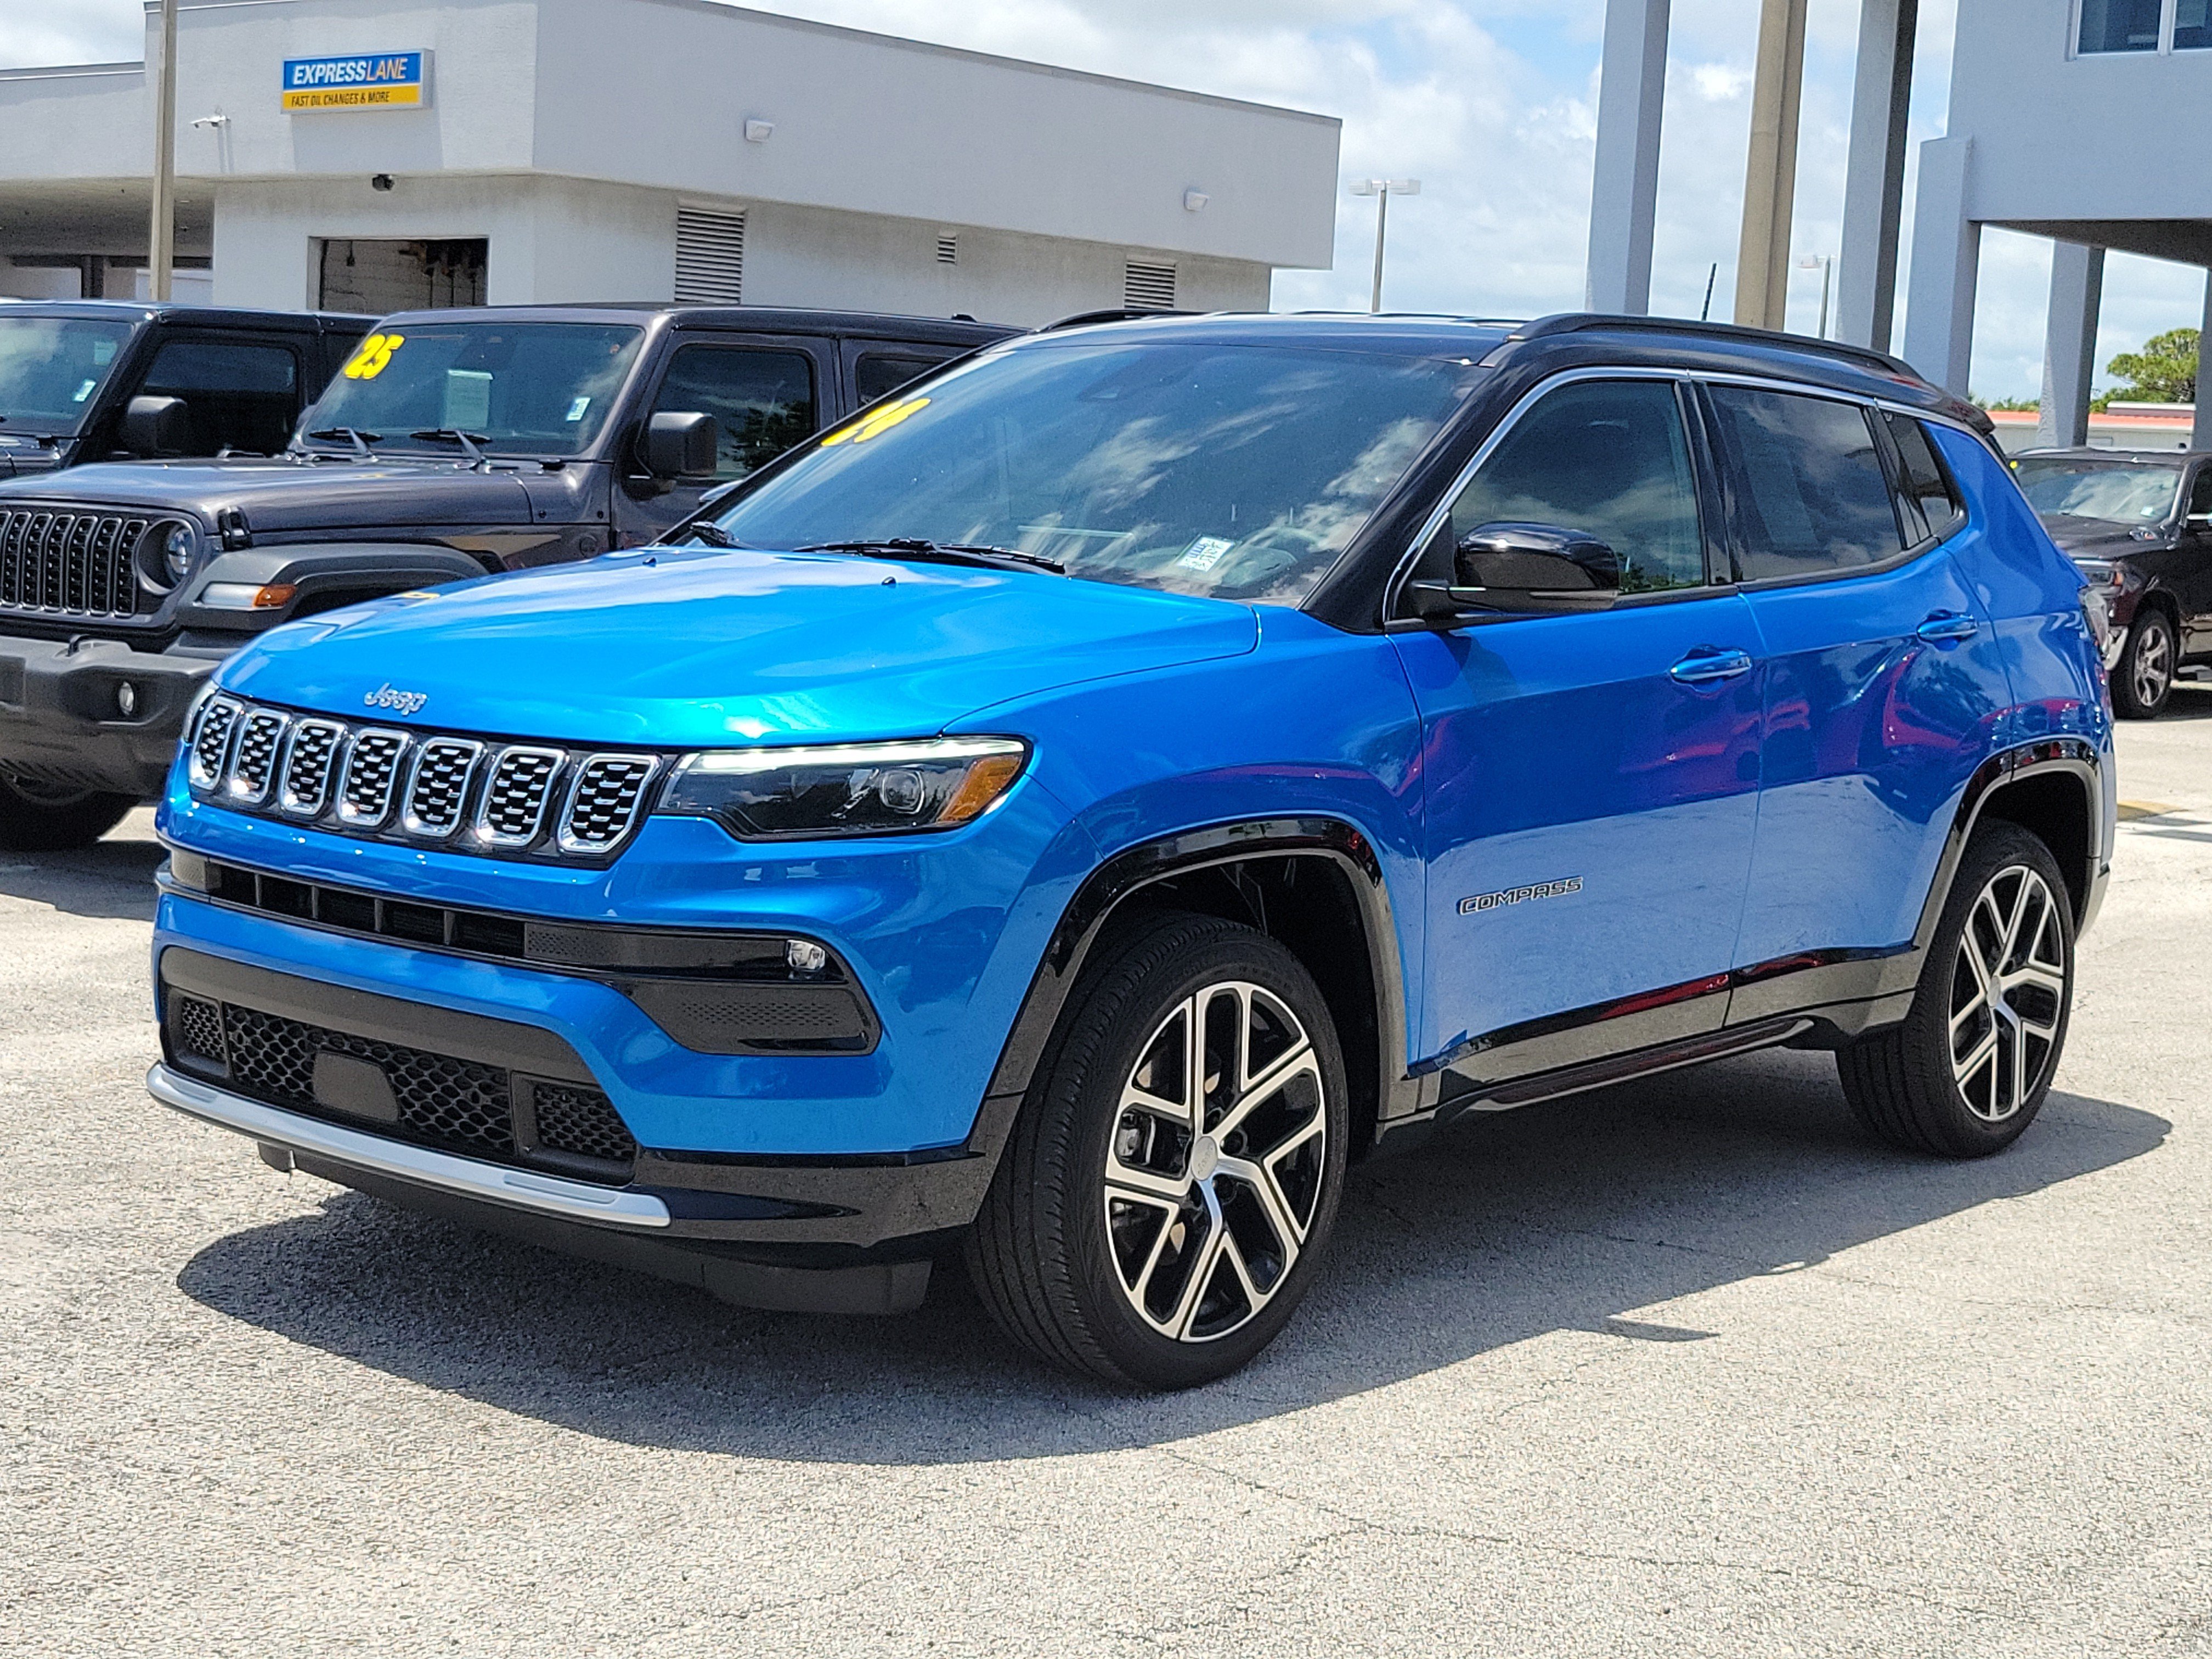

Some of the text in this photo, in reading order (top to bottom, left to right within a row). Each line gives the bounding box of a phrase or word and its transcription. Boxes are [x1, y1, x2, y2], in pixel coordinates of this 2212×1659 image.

[291, 91, 391, 107] FAST OIL CHANGES & MORE
[345, 334, 405, 380] 25
[364, 682, 427, 715] Jeep
[1457, 876, 1583, 916] COMPASS
